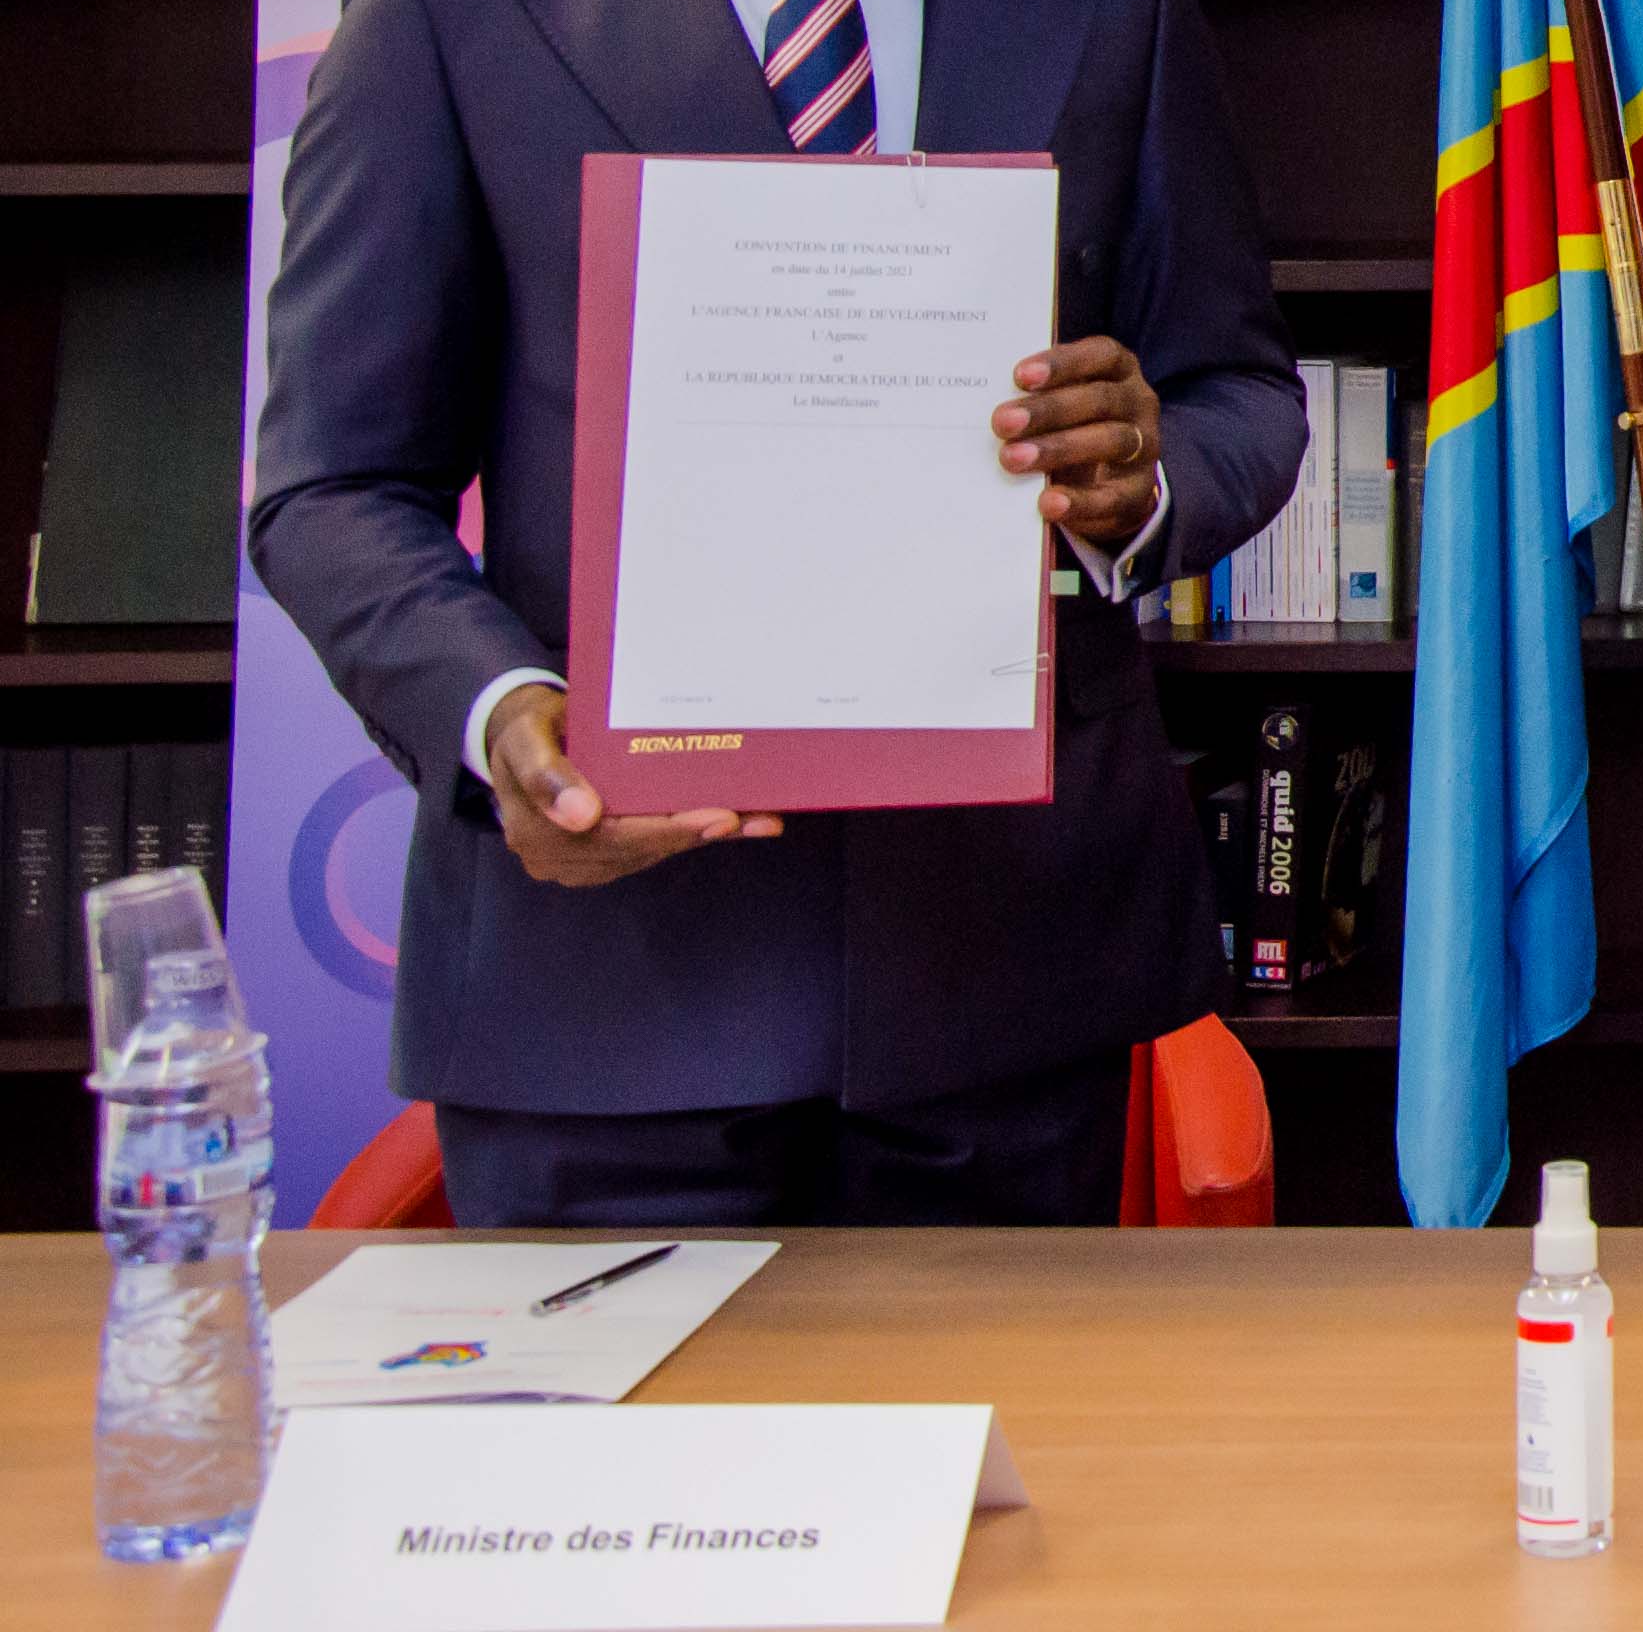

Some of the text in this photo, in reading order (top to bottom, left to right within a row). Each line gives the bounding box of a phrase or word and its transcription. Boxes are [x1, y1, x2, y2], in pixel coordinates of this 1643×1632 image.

[734, 240, 952, 256] CONVENTION DE FINANCEMENT
[788, 265, 811, 275] date
[834, 265, 847, 275] 14
[885, 266, 912, 276] 2021
[692, 306, 760, 318] L'AGENCE
[847, 308, 865, 320] DE
[869, 309, 988, 321] DEVELOPPEMENT
[686, 372, 988, 387] LA REPUBLIQUE DEMOCRATIQUE DU CONGO
[628, 733, 742, 753] SIGNATURES
[1270, 770, 1294, 895] quid 2006
[396, 1522, 820, 1555] Ministre des Finances
